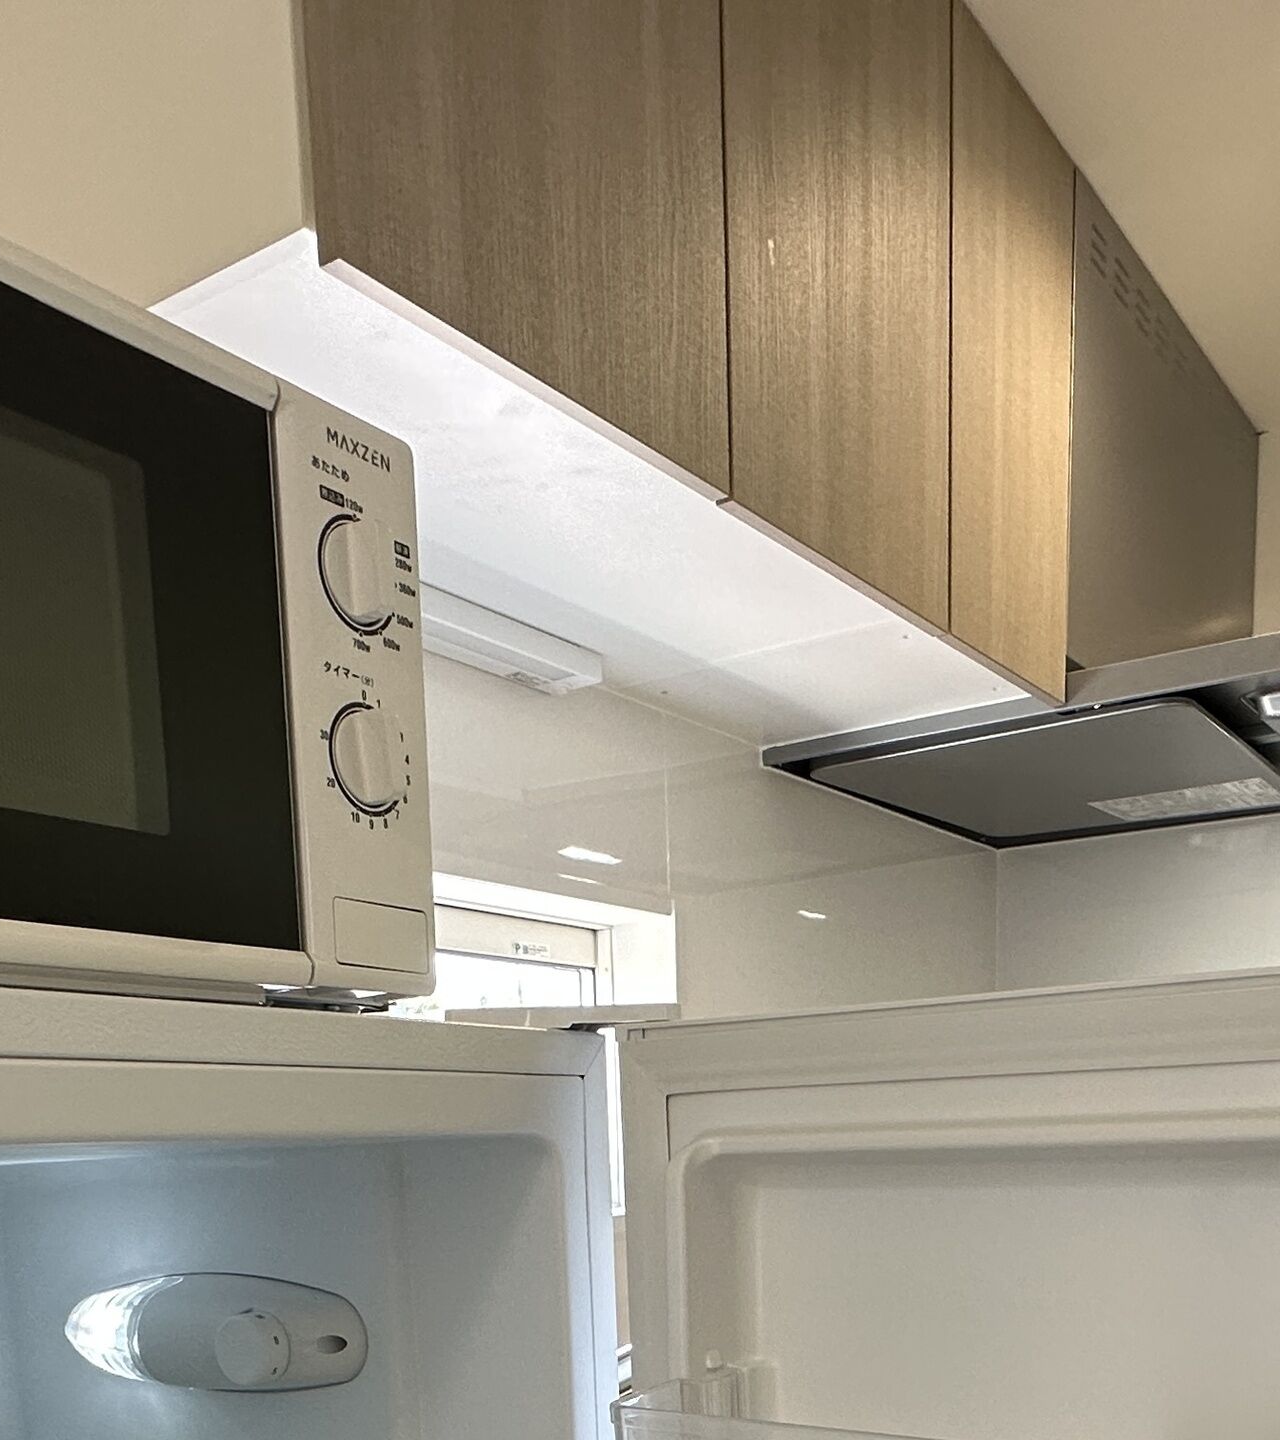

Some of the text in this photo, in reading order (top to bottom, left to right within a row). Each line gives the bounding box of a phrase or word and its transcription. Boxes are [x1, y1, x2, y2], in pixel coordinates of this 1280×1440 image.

[326, 426, 391, 473] MAXZEN
[311, 455, 350, 482] あたため
[361, 689, 368, 701] 0
[351, 811, 361, 824] 10
[383, 818, 389, 829] 8
[368, 819, 374, 830] 9
